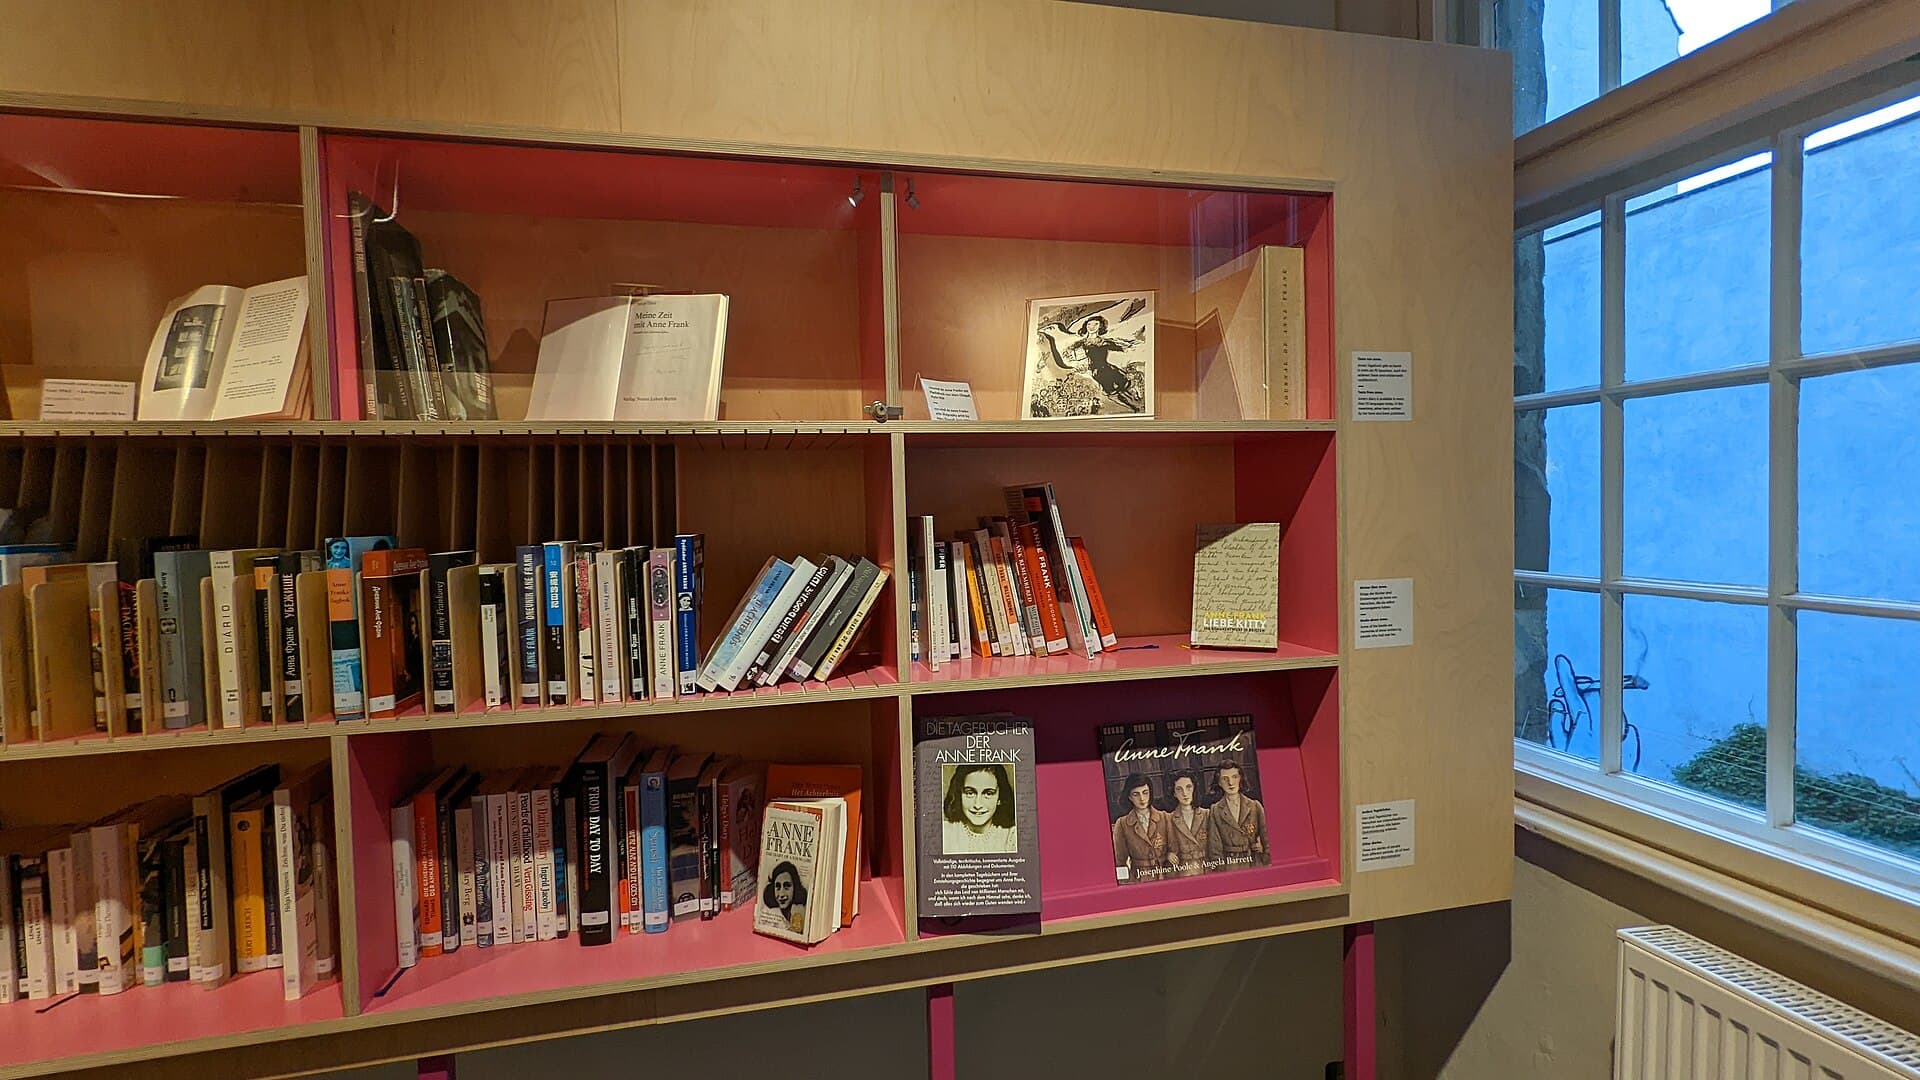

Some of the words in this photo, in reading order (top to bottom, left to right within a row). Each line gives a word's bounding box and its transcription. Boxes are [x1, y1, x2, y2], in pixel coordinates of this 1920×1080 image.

[355, 237, 364, 254] ANNE
[356, 254, 366, 273] FRANK
[635, 312, 656, 320] Meine
[668, 320, 690, 328] Frank
[366, 383, 376, 415] DOUBLEDAY
[523, 553, 534, 576] FRANK
[524, 577, 534, 590] ANE
[1030, 526, 1044, 554] ANNE
[1037, 556, 1053, 589] FRANK
[1047, 603, 1062, 636] BIOGRAPHY
[162, 592, 170, 612] Frank
[524, 592, 535, 620] DNEVNIK
[1204, 618, 1234, 628] LIEBE
[1236, 619, 1266, 628] KITTY
[1233, 612, 1266, 620] FRANK
[284, 626, 297, 654] Франк
[525, 627, 536, 650] FRANK
[658, 624, 666, 650] FRANK
[285, 656, 296, 678] Анна
[526, 651, 537, 668] ANNE
[658, 652, 667, 675] ANNE
[926, 722, 945, 735] DIE
[966, 736, 990, 748] DER
[1114, 737, 1174, 763] Anne
[1172, 729, 1244, 760] Frank
[935, 749, 976, 762] ANNE
[979, 748, 1022, 762] FRANK
[536, 794, 548, 806] My
[588, 786, 600, 812] FROM
[792, 788, 804, 796] Het
[520, 795, 530, 818] Pearls
[536, 808, 549, 838] Darling
[590, 816, 600, 835] DAY
[767, 821, 815, 843] ANNE
[522, 827, 532, 864] Childhood
[536, 839, 550, 860] Diary
[590, 838, 601, 851] TO
[766, 837, 813, 858] FRANK
[590, 854, 602, 874] DAY
[1136, 865, 1172, 879] Josephine
[1172, 862, 1192, 872] Poole
[1200, 858, 1226, 870] Angela
[1226, 855, 1254, 865] Barrett
[464, 866, 472, 886] Mary
[524, 866, 532, 884] Vera
[540, 866, 550, 887] Ingrid
[464, 888, 473, 906] Berg
[523, 884, 534, 911] Gissing
[540, 888, 550, 910] Jacoby
[630, 883, 638, 897] GOES
